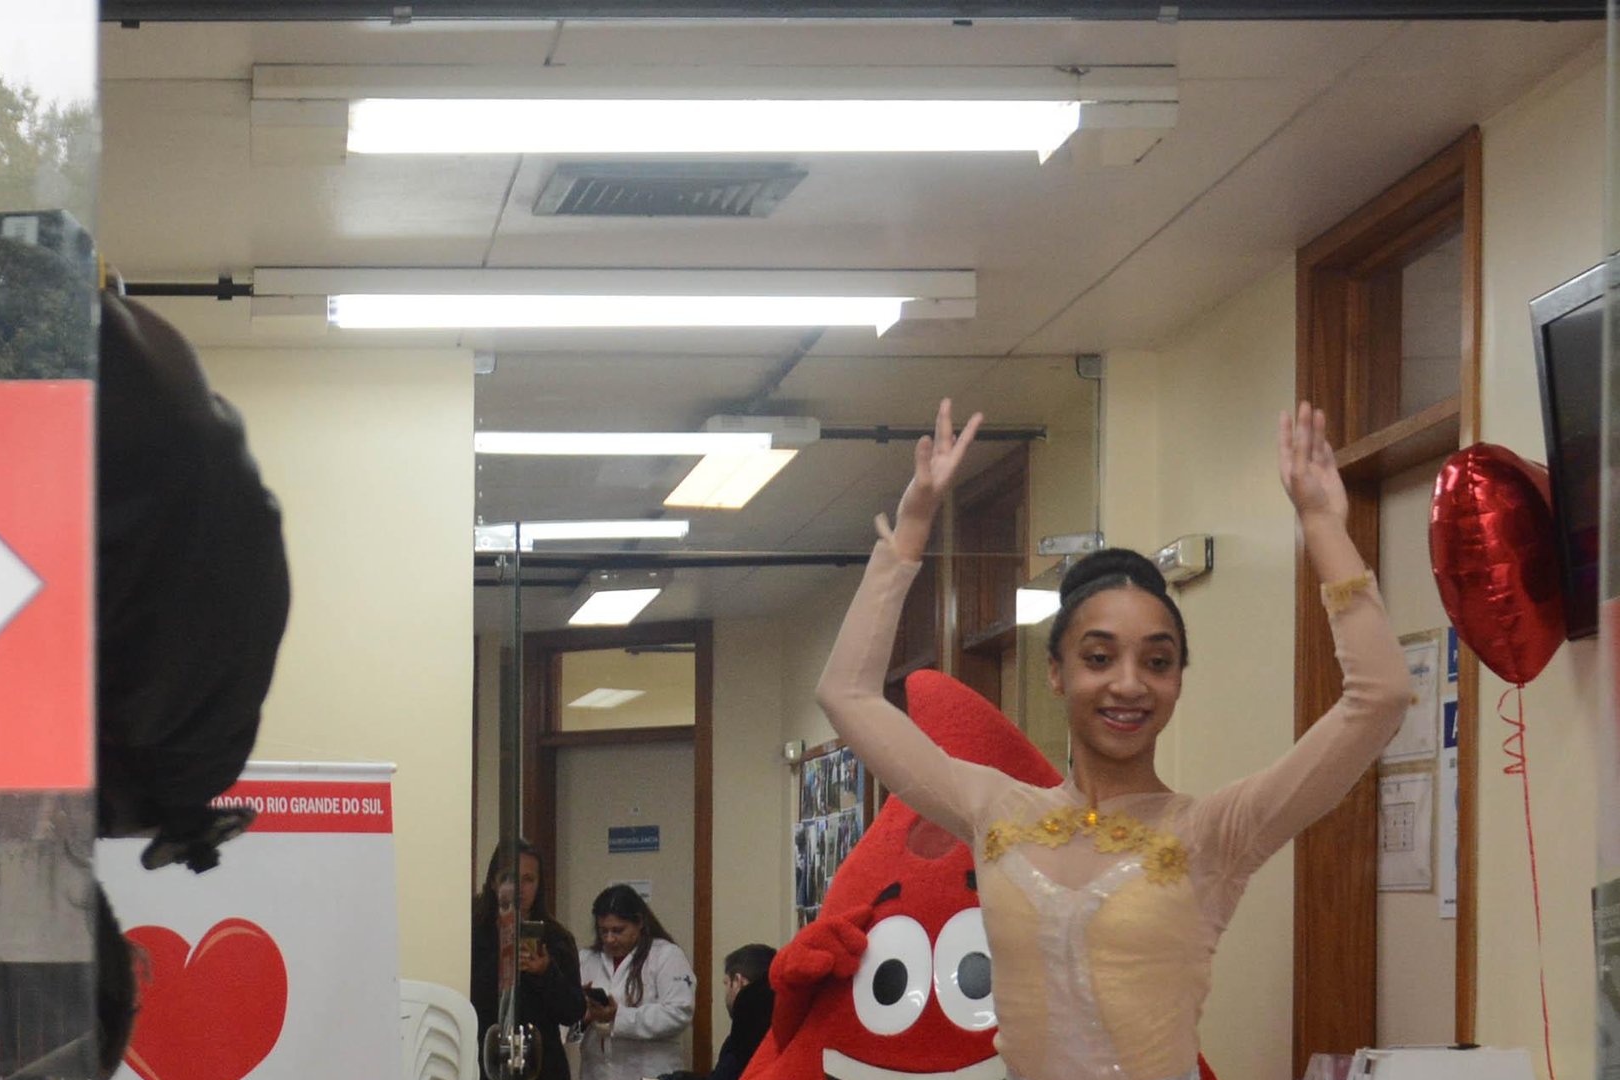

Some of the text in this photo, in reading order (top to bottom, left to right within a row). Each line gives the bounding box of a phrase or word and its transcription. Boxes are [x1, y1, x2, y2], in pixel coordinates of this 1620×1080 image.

[266, 796, 287, 814] RIO
[290, 797, 340, 814] GRANDE
[342, 798, 360, 815] DO
[362, 798, 383, 815] SUL
